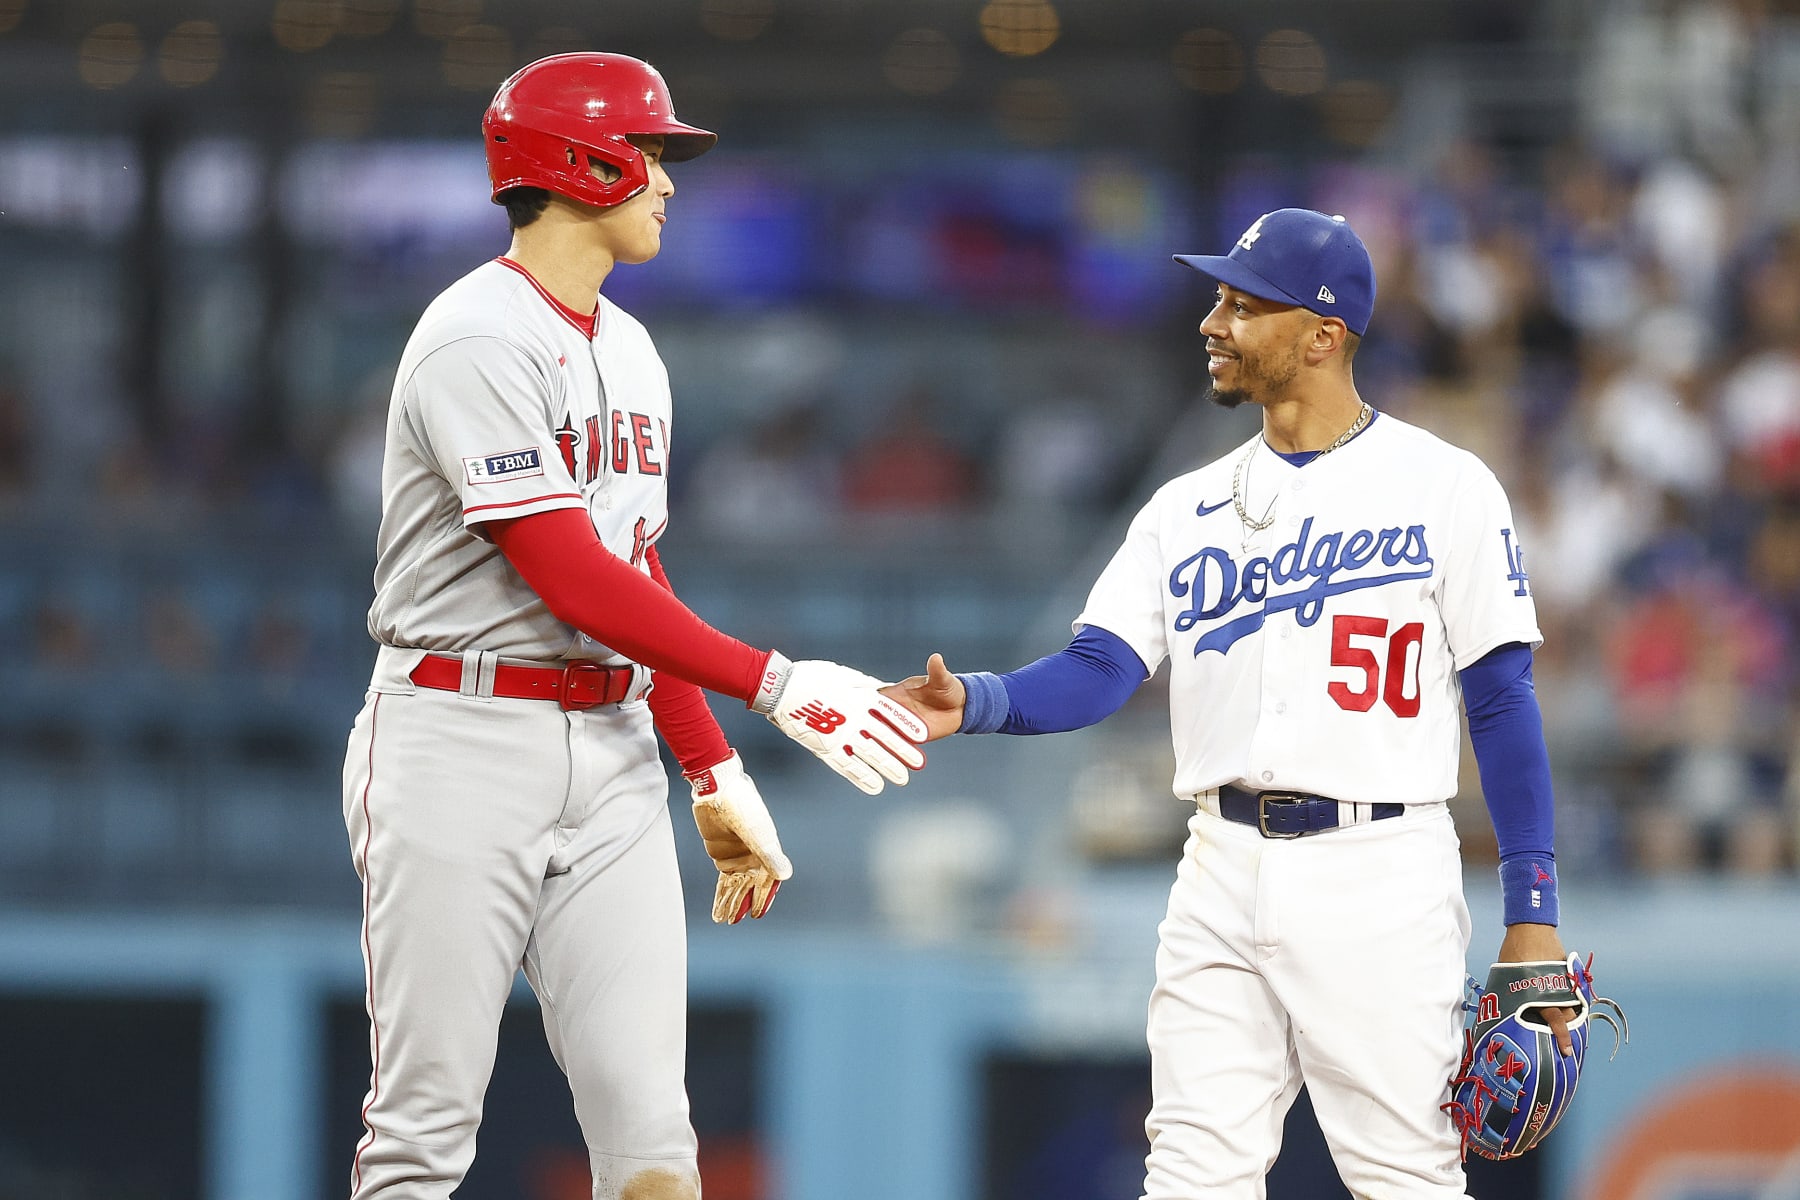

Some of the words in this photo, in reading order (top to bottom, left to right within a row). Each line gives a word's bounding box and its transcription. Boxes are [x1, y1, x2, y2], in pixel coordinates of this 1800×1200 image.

[490, 453, 535, 473] FBM
[554, 410, 670, 486] ANGE
[1170, 516, 1434, 632] Dodgers
[1327, 614, 1425, 718] 50
[878, 700, 894, 712] new
[893, 709, 920, 734] balance
[1530, 889, 1541, 908] MB
[1508, 975, 1569, 993] Wilson
[1529, 1101, 1549, 1132] A2K
